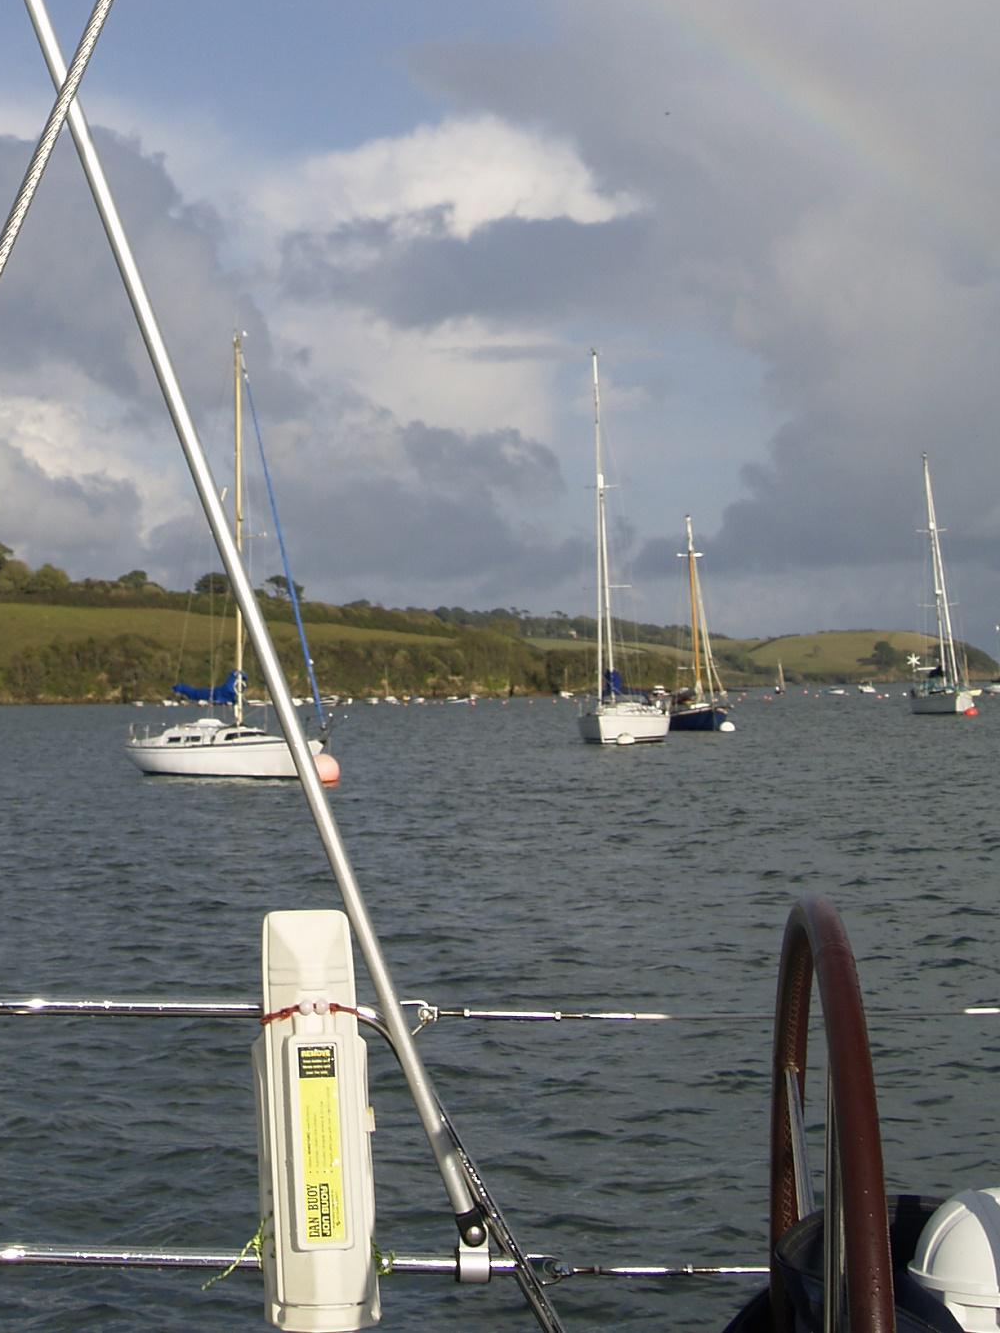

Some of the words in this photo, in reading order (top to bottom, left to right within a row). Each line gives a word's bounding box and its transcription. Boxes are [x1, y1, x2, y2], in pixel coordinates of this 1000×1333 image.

[307, 1184, 319, 1210] BUOY
[321, 1185, 330, 1214] BUOY
[309, 1217, 320, 1238] DAN
